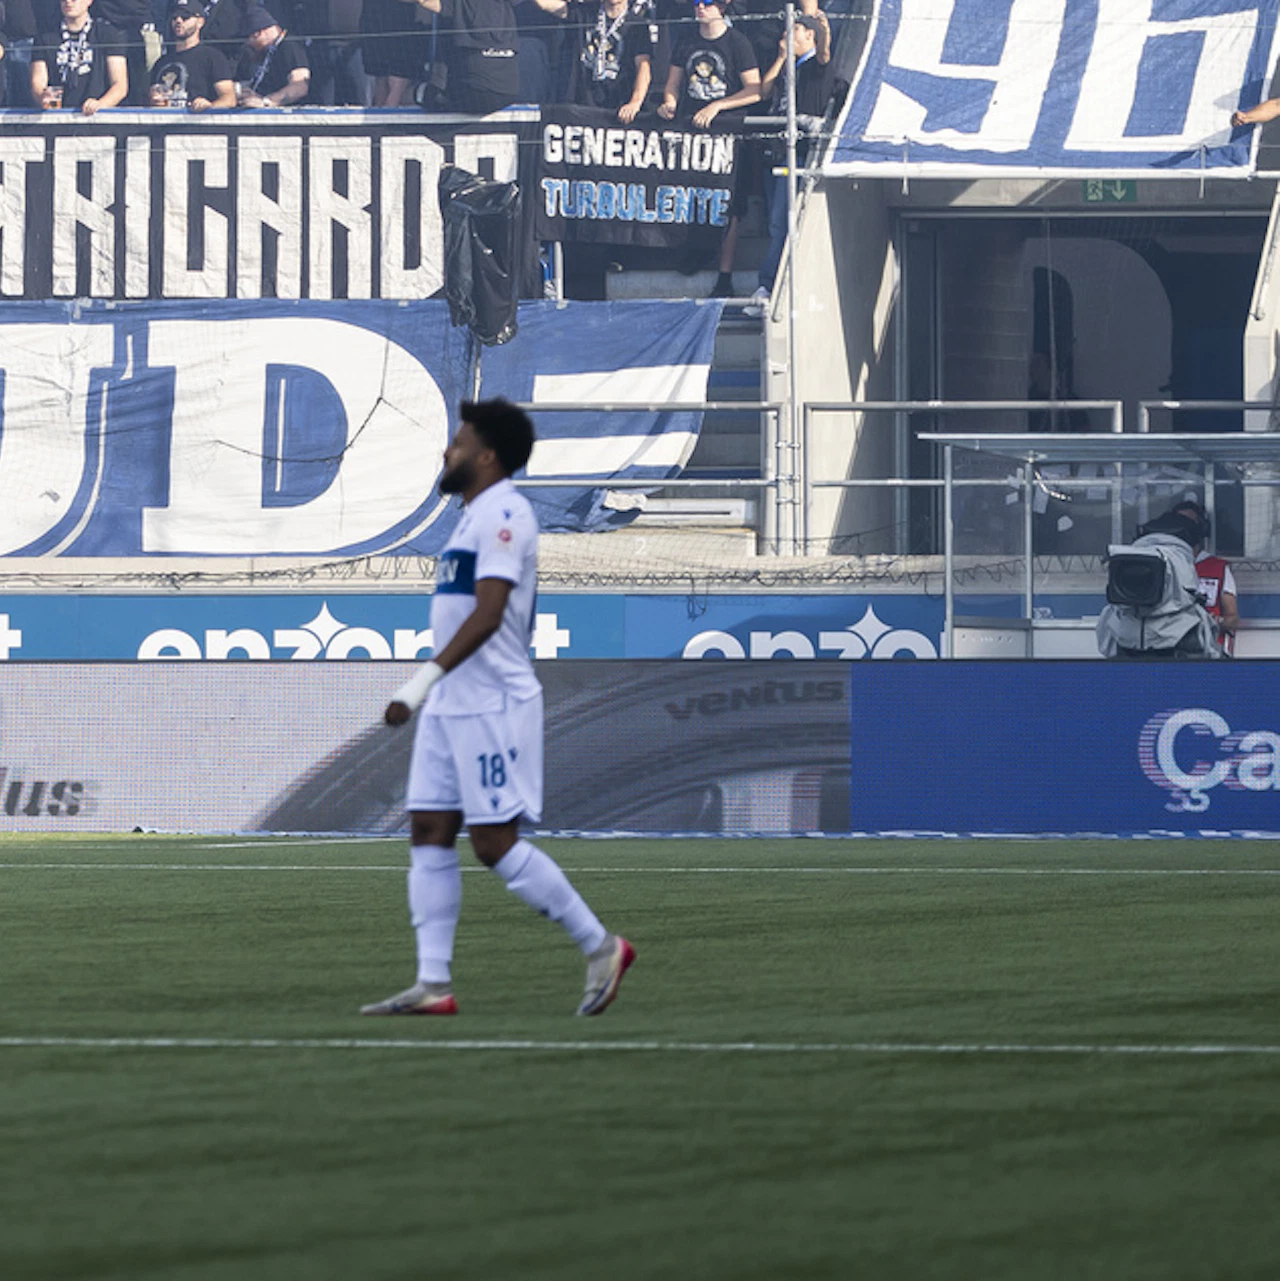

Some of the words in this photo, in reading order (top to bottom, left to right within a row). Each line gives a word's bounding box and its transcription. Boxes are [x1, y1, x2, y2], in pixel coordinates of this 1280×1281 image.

[542, 123, 734, 176] GENERATION
[542, 178, 731, 227] TURBULENTE
[477, 753, 506, 788] 18
